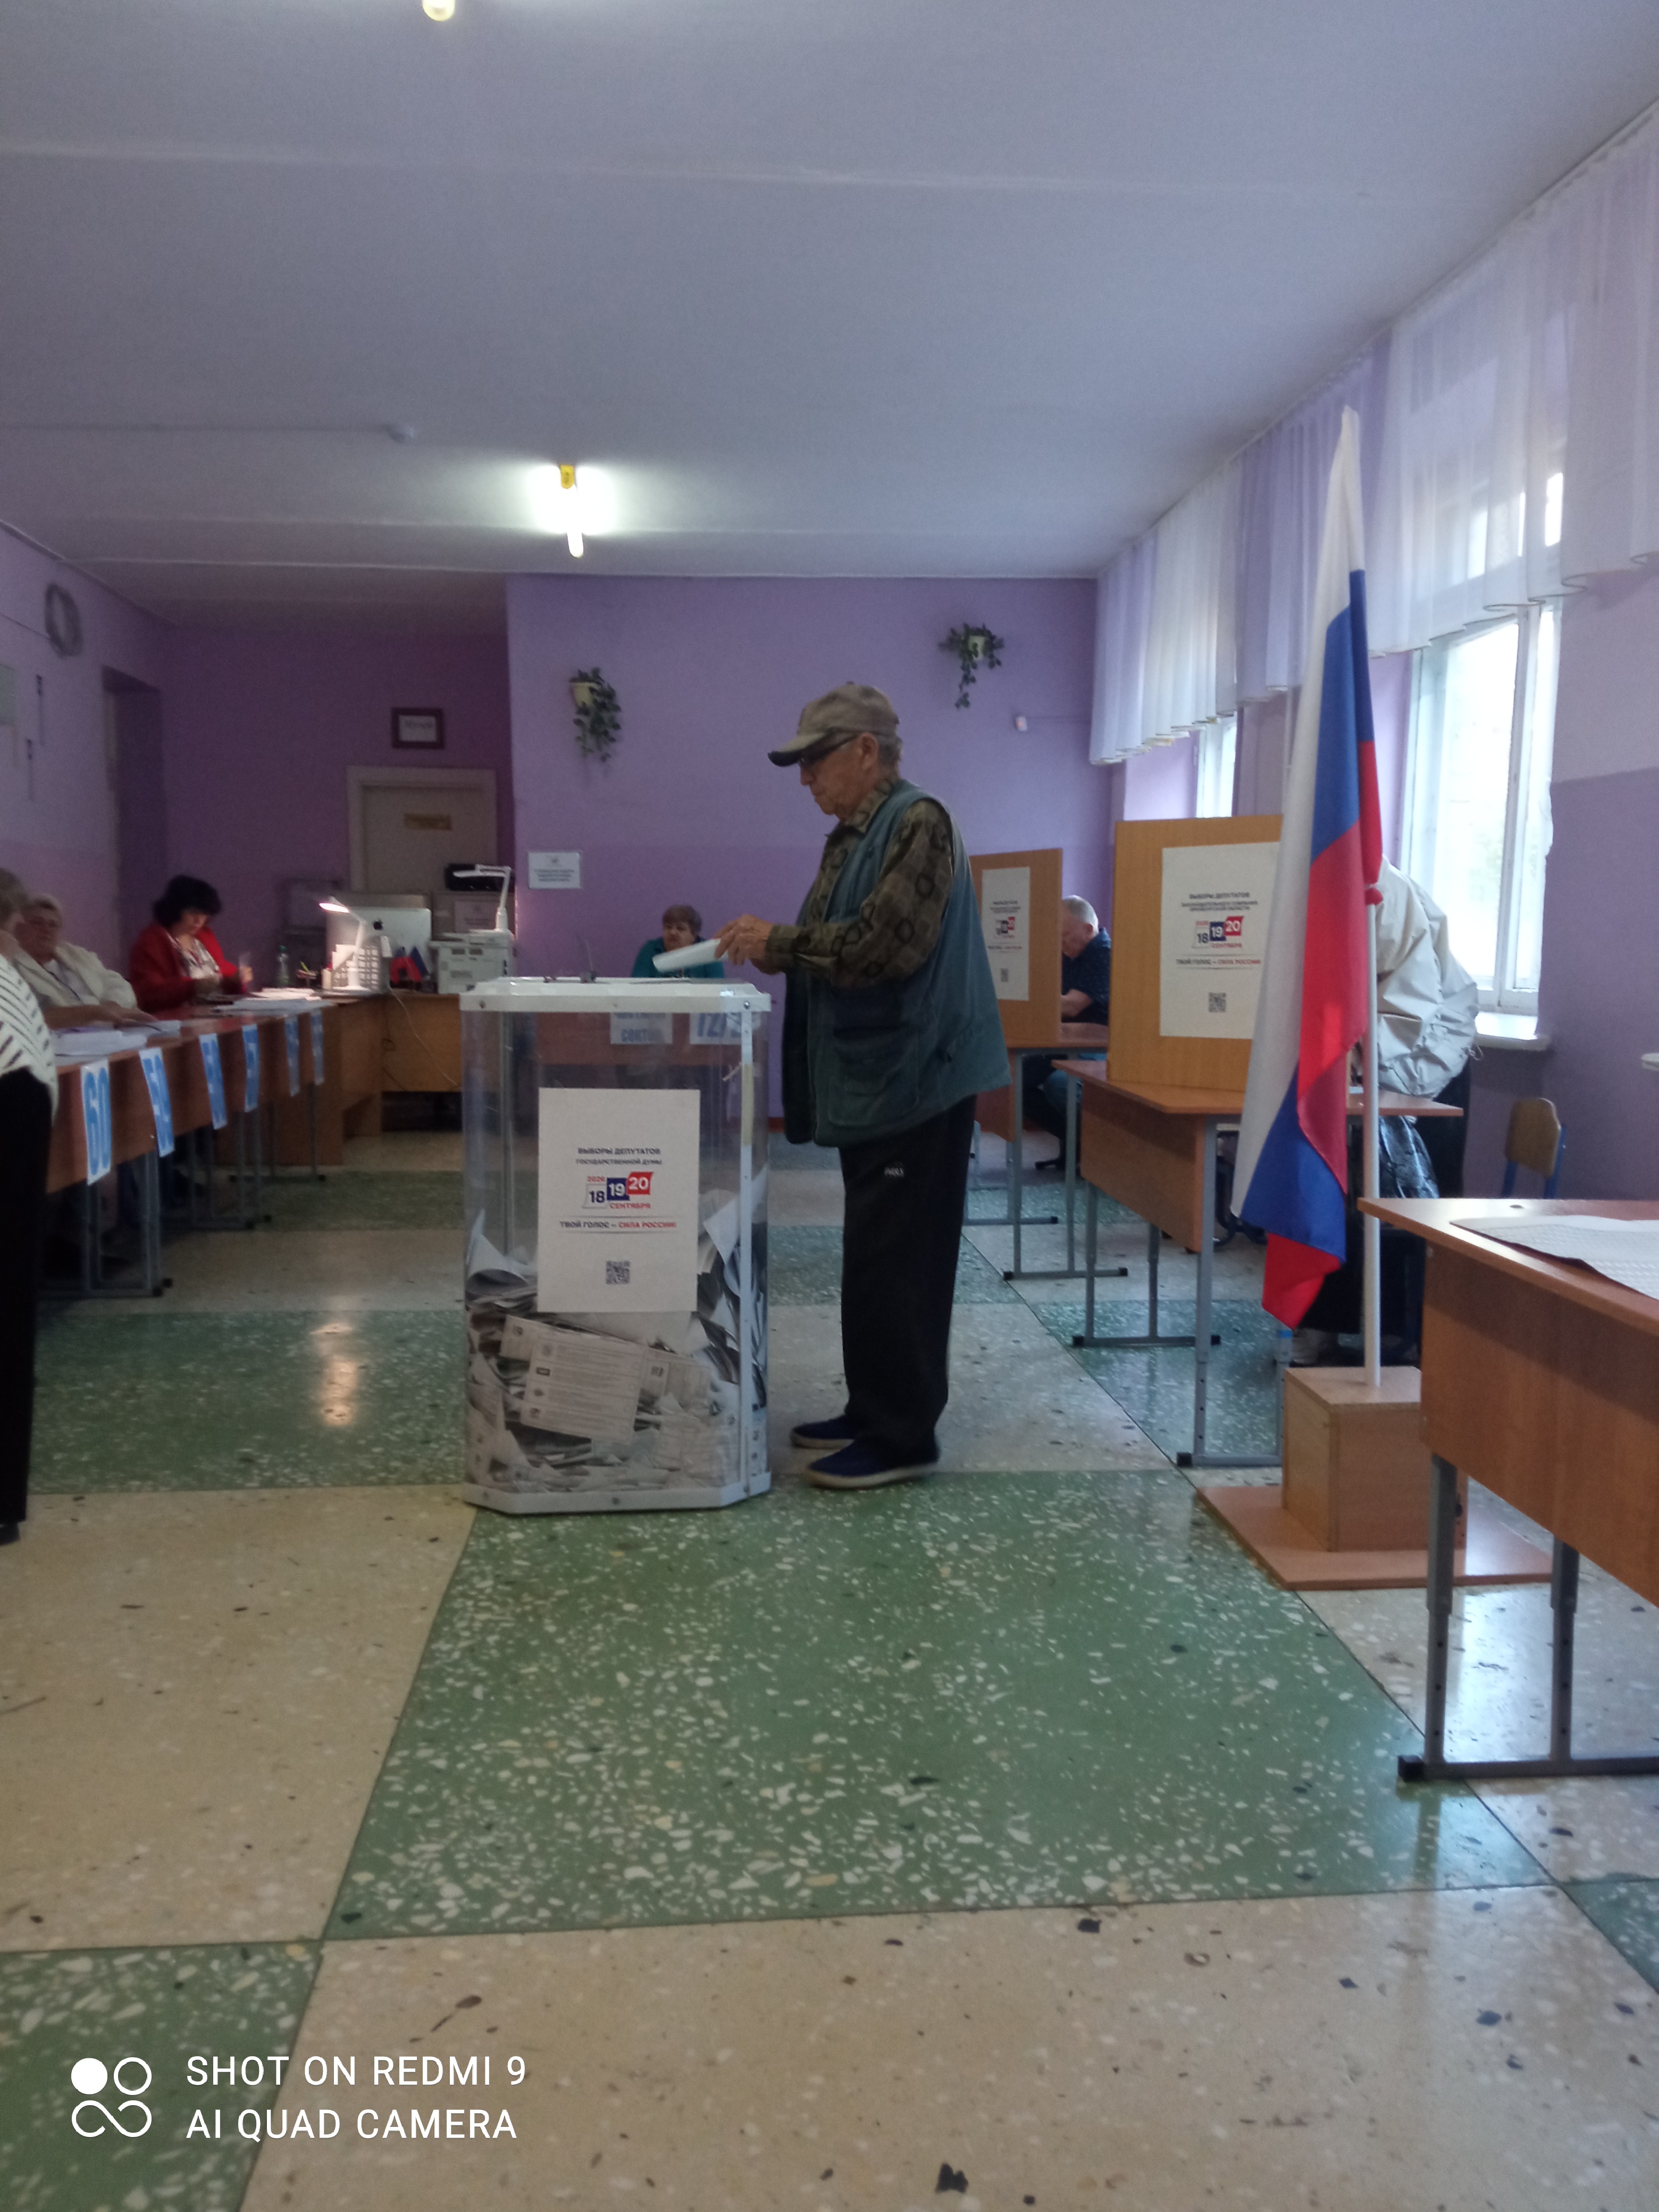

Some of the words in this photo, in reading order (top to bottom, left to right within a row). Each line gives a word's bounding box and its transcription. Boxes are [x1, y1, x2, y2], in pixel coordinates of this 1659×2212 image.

[1197, 933, 1209, 943] 18
[1211, 926, 1222, 937] 19
[1225, 920, 1240, 932] 20
[589, 1191, 605, 1203] 18
[609, 1183, 625, 1196] 19
[629, 1177, 649, 1190] 20
